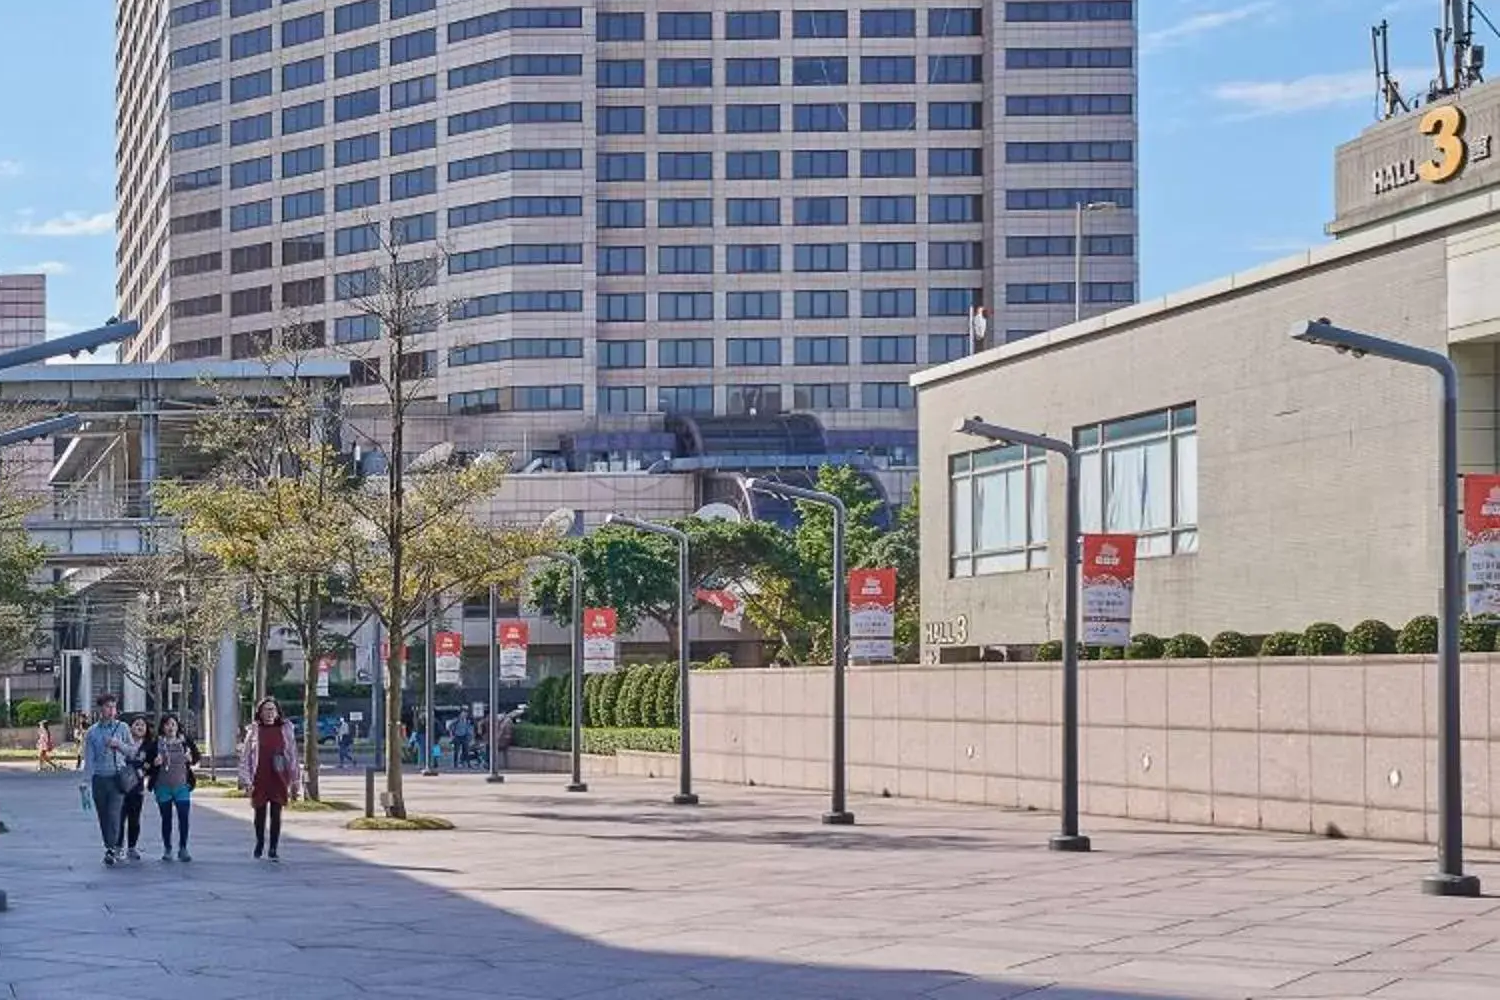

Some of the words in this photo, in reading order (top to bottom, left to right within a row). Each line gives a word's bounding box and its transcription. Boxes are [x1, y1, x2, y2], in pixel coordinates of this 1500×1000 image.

[1372, 157, 1420, 194] HALL
[1418, 105, 1466, 184] 3
[957, 614, 968, 644] 3
